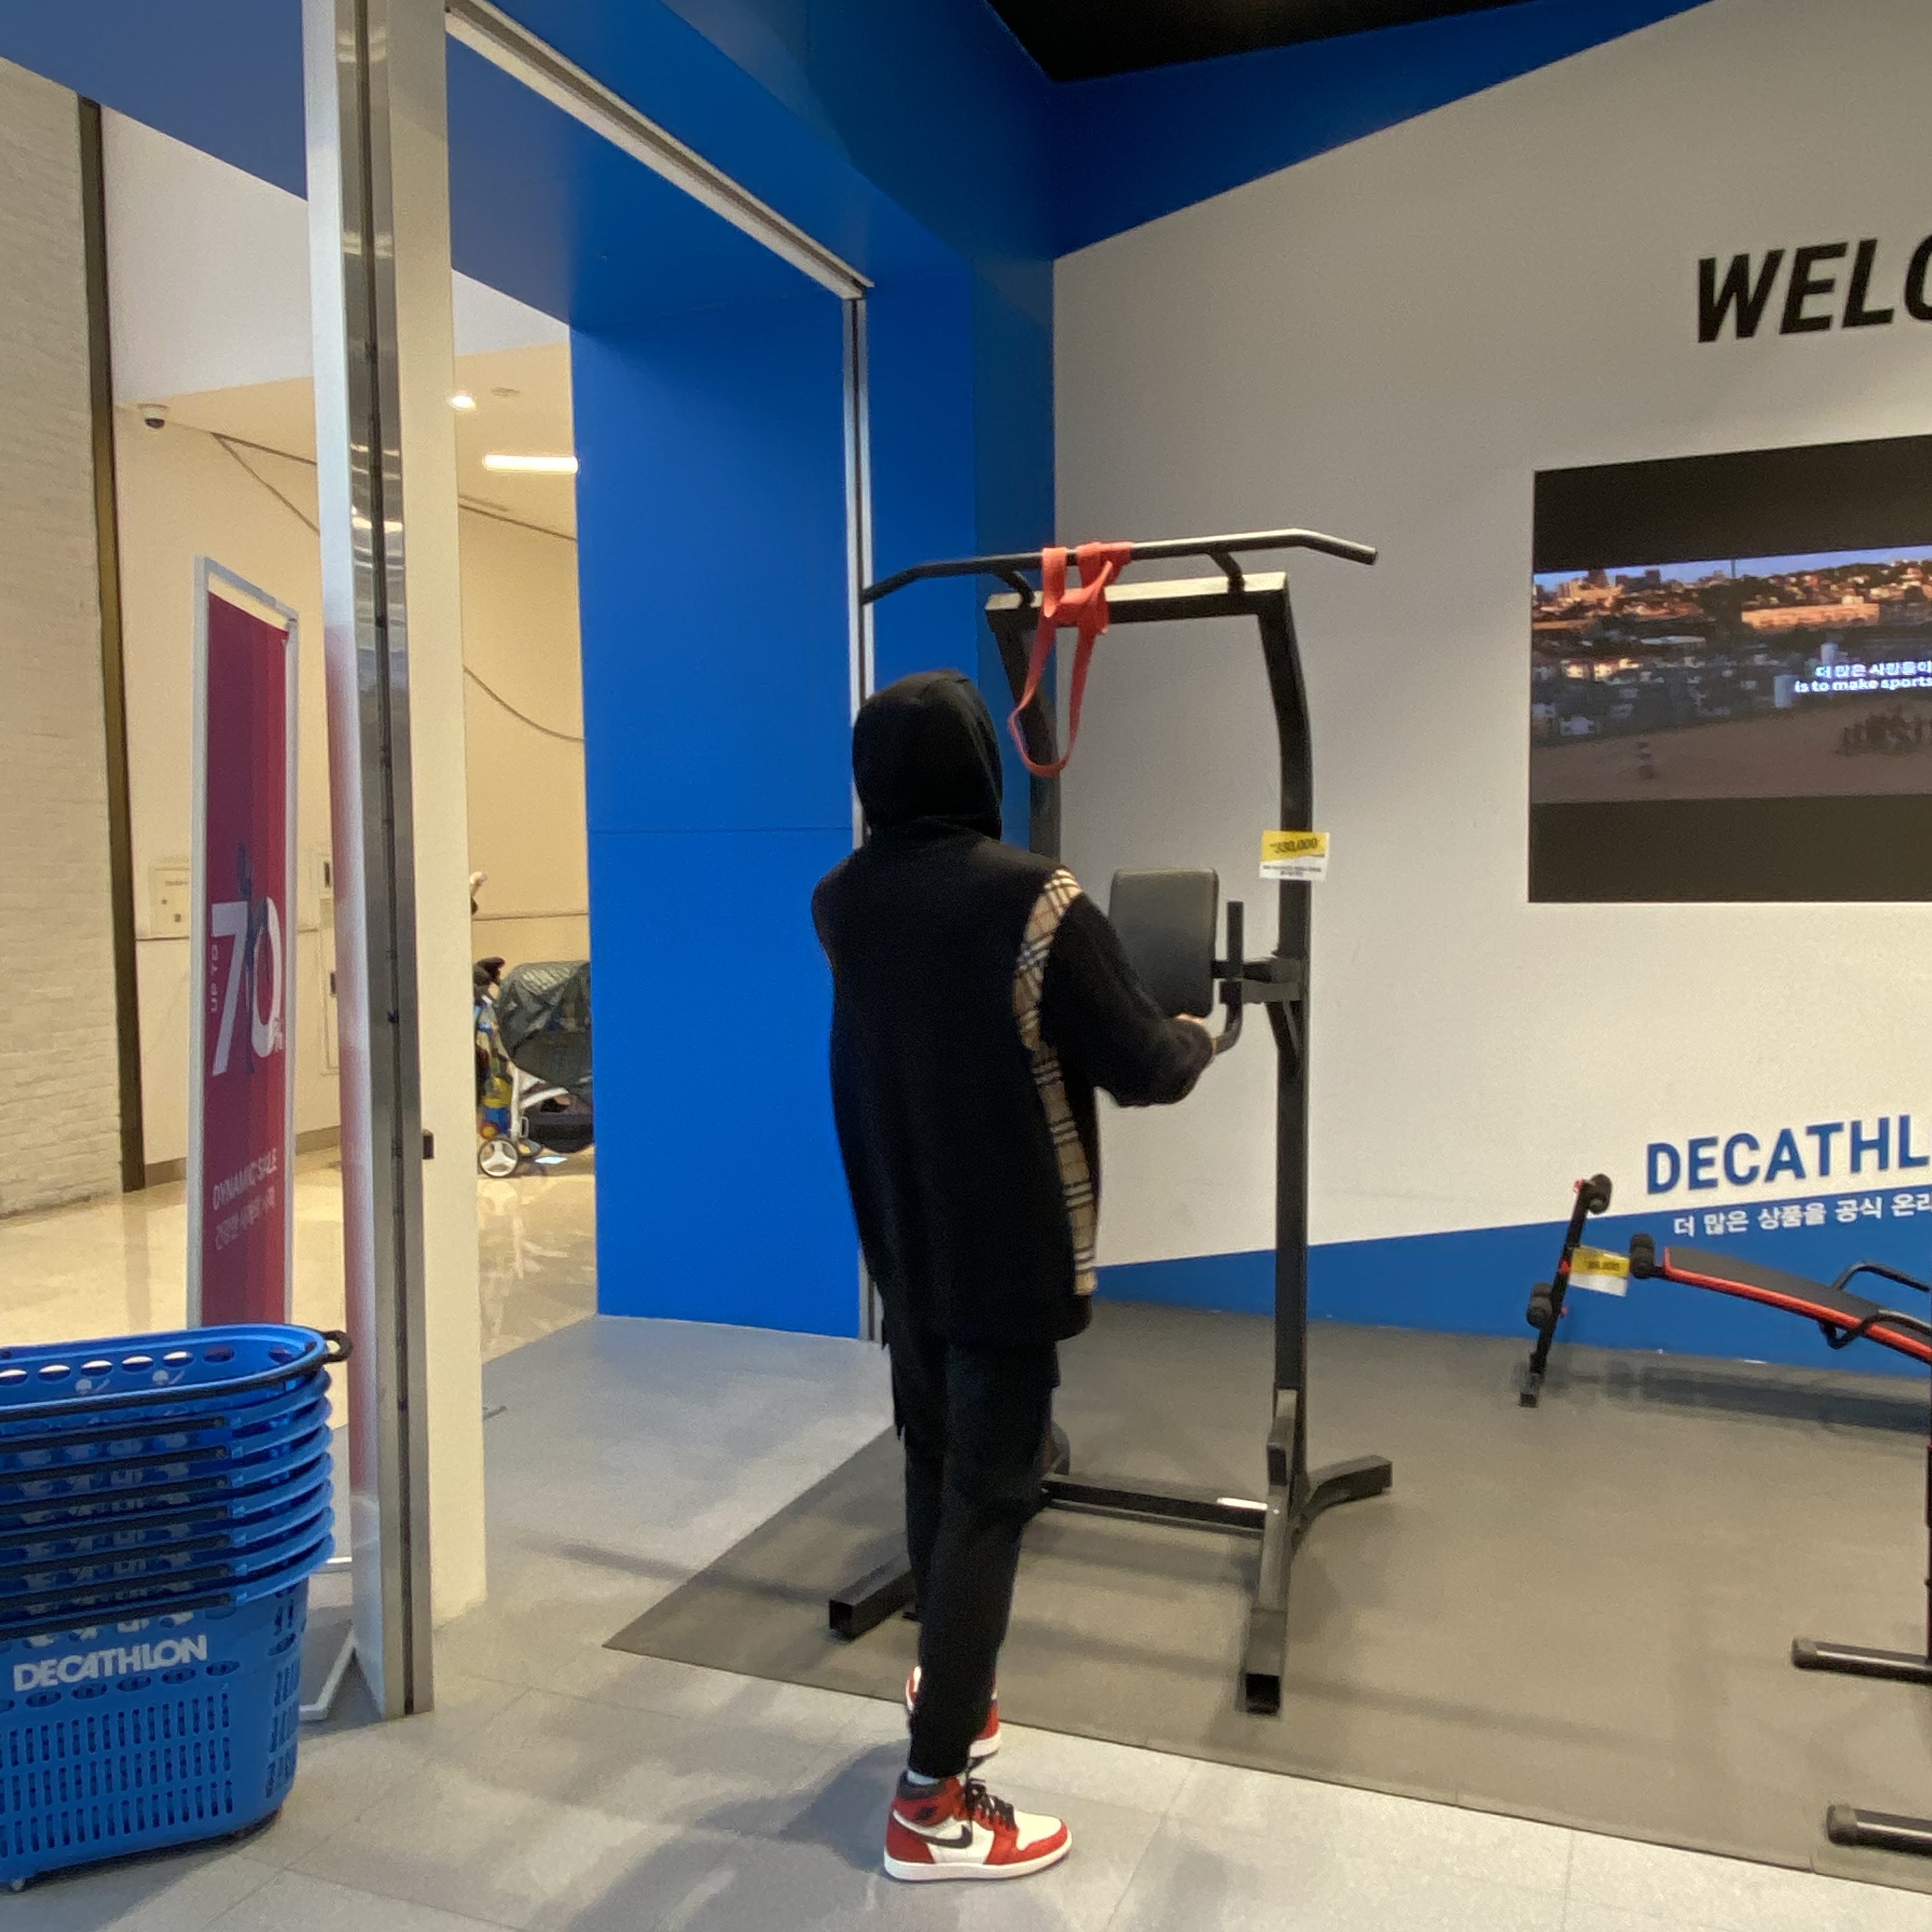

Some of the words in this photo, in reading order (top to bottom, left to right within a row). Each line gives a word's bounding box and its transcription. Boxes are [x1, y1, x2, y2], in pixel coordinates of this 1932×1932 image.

[1795, 681, 1809, 693] is
[1811, 681, 1830, 691] to
[1832, 678, 1879, 691] make
[1674, 1215, 1695, 1237] 더
[1703, 1210, 1749, 1235] 많은
[1757, 1203, 1826, 1230] 상품을
[1835, 1195, 1883, 1222] 공식
[13, 1634, 208, 1692] DECATHLON
